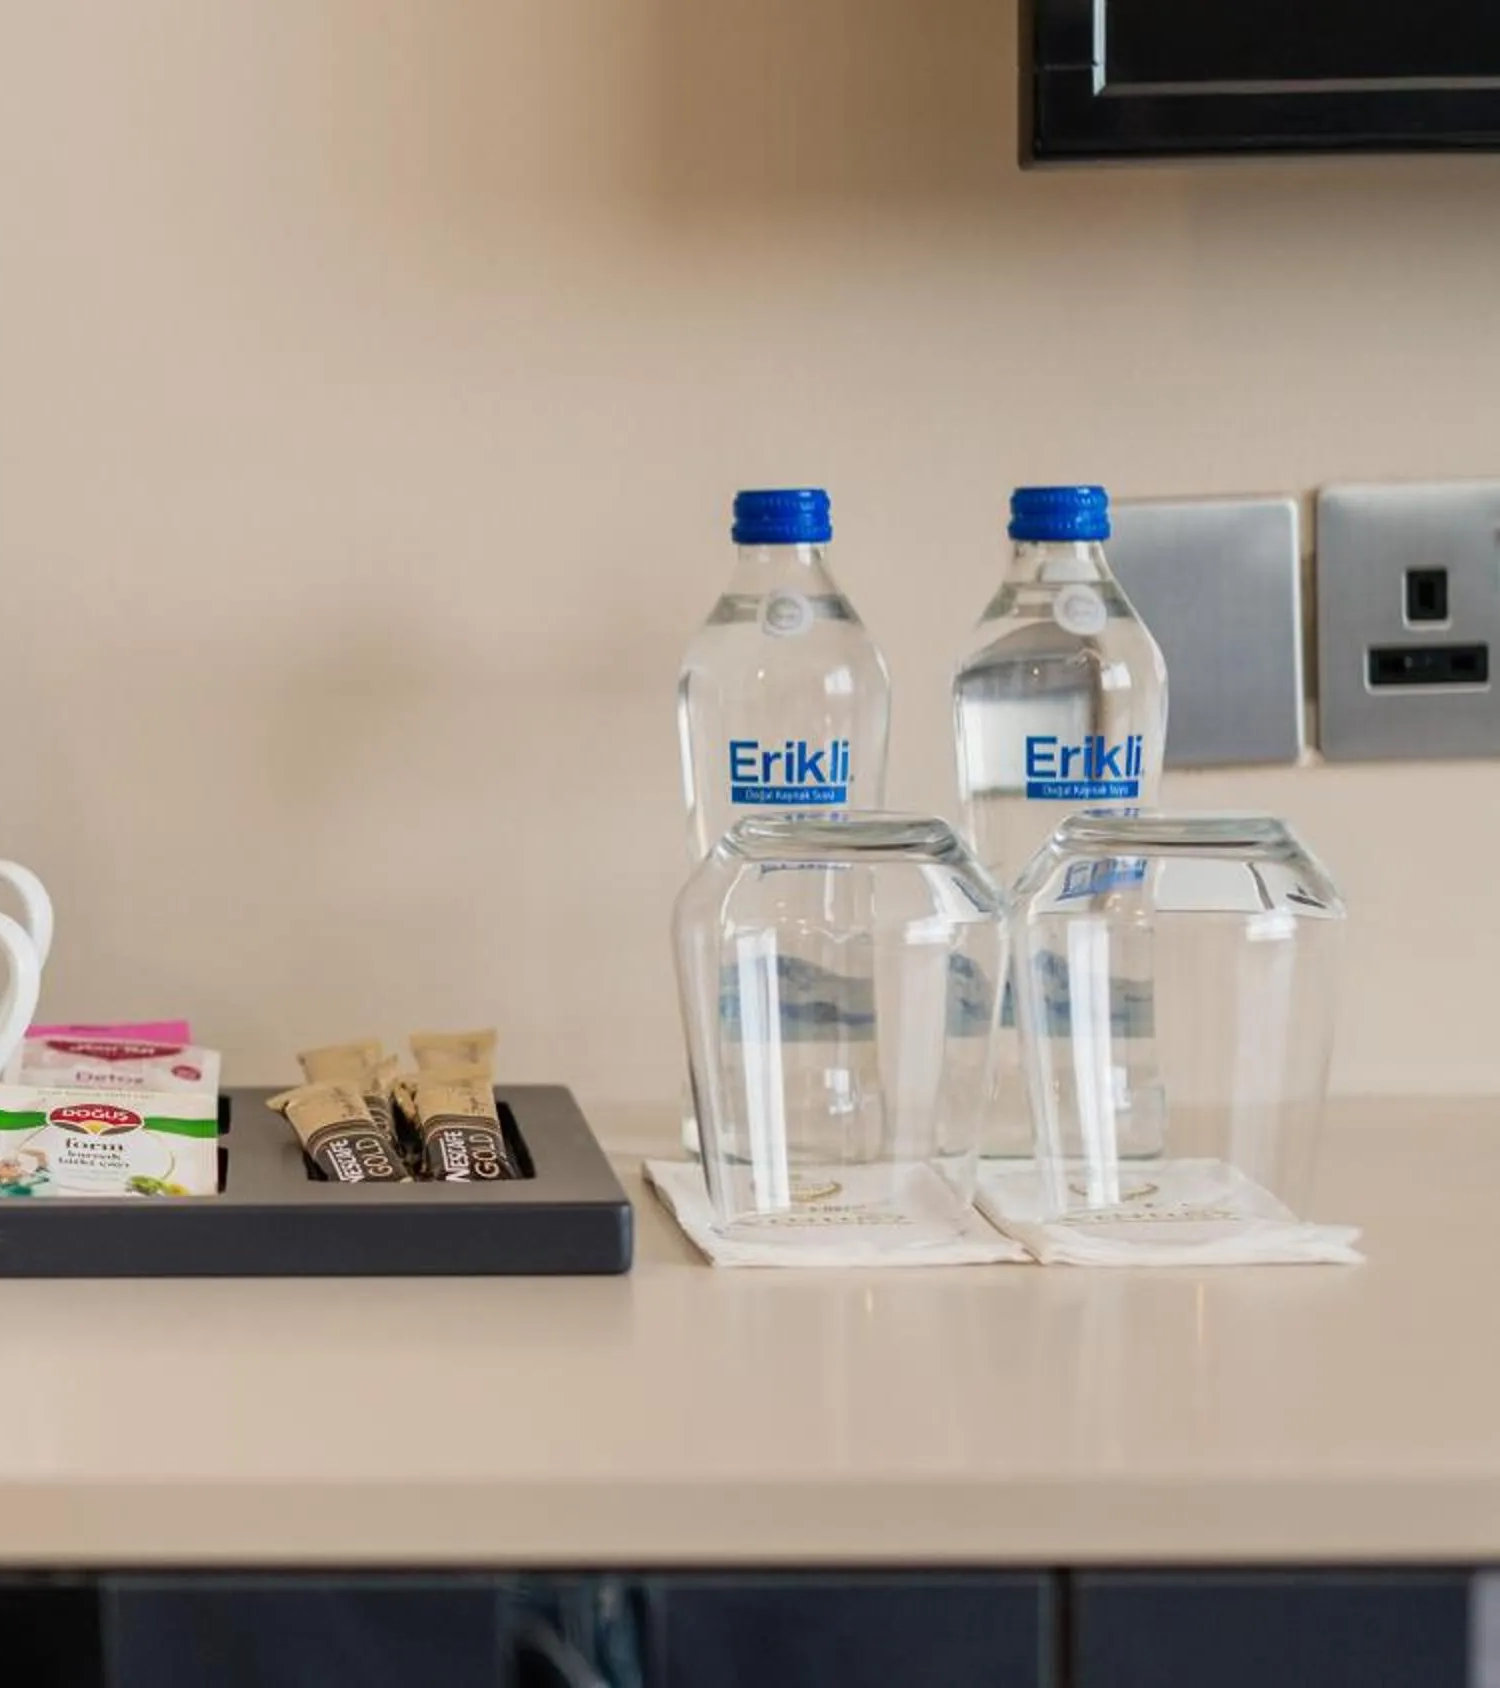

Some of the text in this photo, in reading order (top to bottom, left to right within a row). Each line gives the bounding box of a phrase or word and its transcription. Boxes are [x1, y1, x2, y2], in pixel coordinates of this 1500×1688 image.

[729, 740, 849, 783] Erikli
[1026, 735, 1142, 778] Erikli
[356, 1137, 393, 1177] GOLD
[469, 1133, 500, 1178] GOLD
